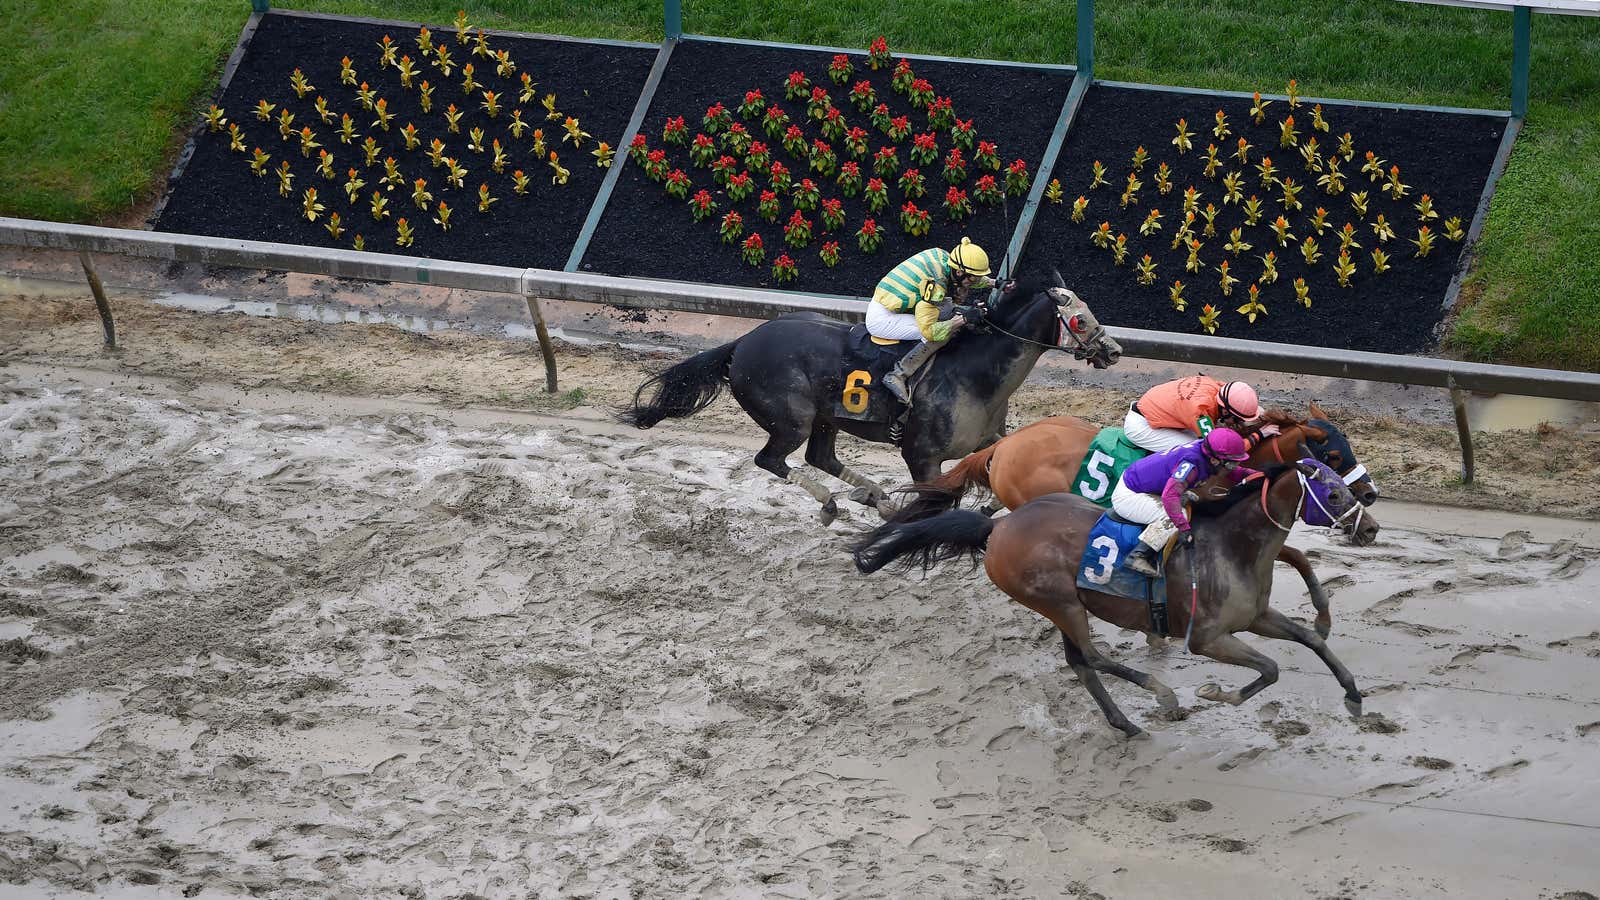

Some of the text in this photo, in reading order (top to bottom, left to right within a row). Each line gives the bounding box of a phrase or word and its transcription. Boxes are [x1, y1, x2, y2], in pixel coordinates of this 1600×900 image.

[924, 283, 934, 301] 6
[843, 369, 872, 414] 6
[1200, 418, 1212, 436] 5
[1079, 449, 1115, 501] 5
[1175, 462, 1191, 479] 3
[1084, 535, 1119, 585] 3
